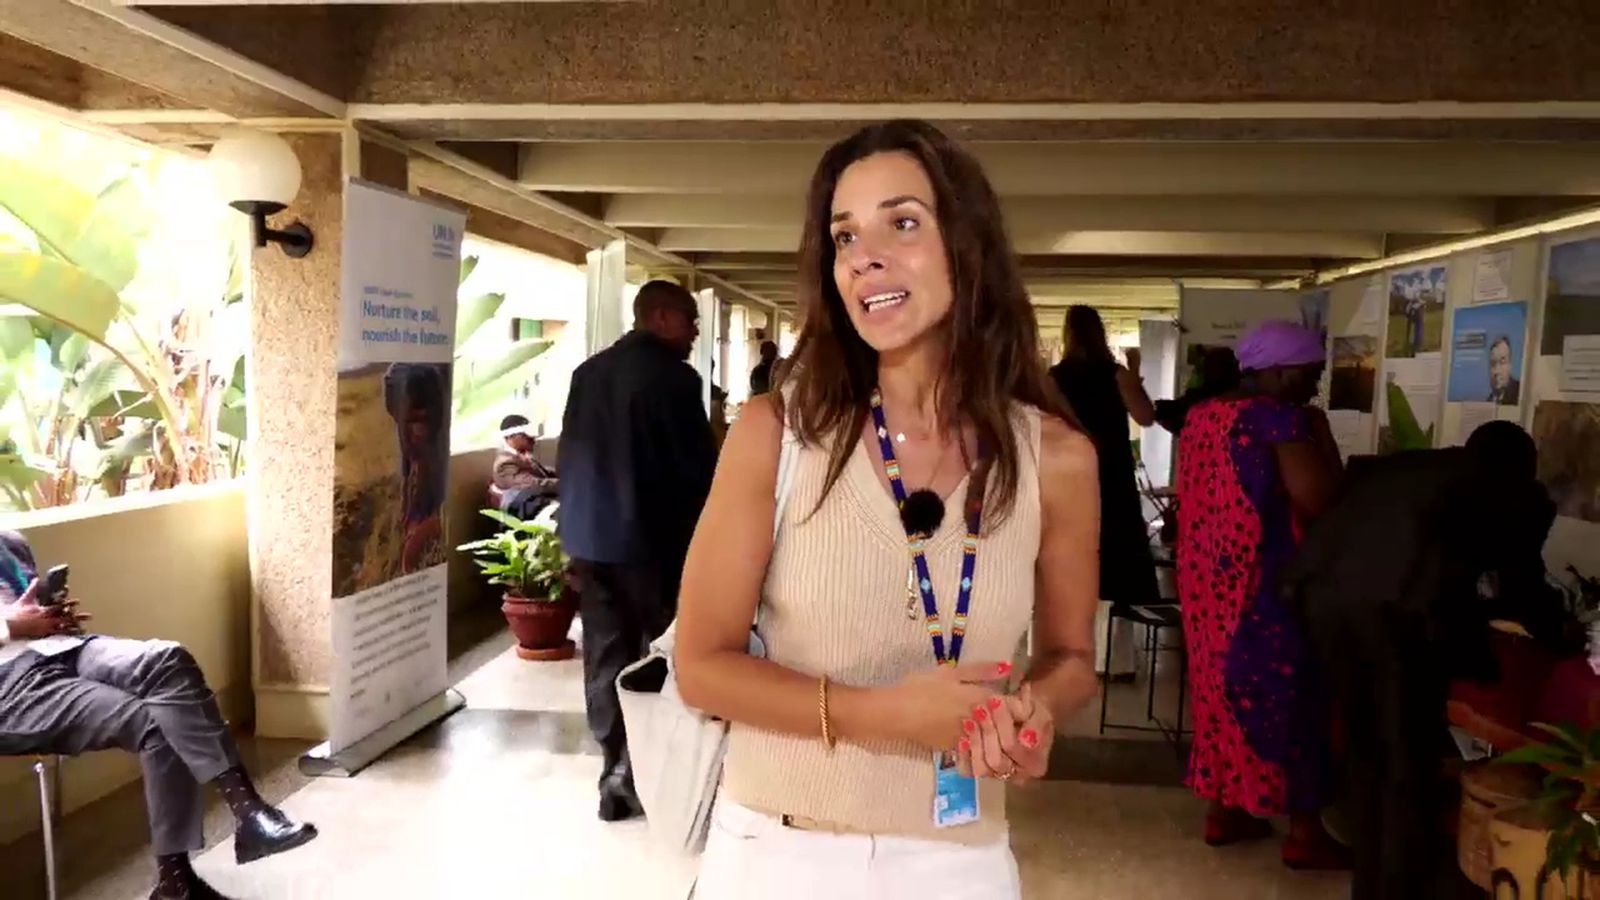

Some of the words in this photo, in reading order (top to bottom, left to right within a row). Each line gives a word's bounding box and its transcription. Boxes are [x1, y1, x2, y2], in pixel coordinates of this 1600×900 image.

[363, 300, 401, 319] Nurture
[403, 306, 419, 321] the
[362, 327, 401, 347] nourish
[402, 329, 418, 344] the
